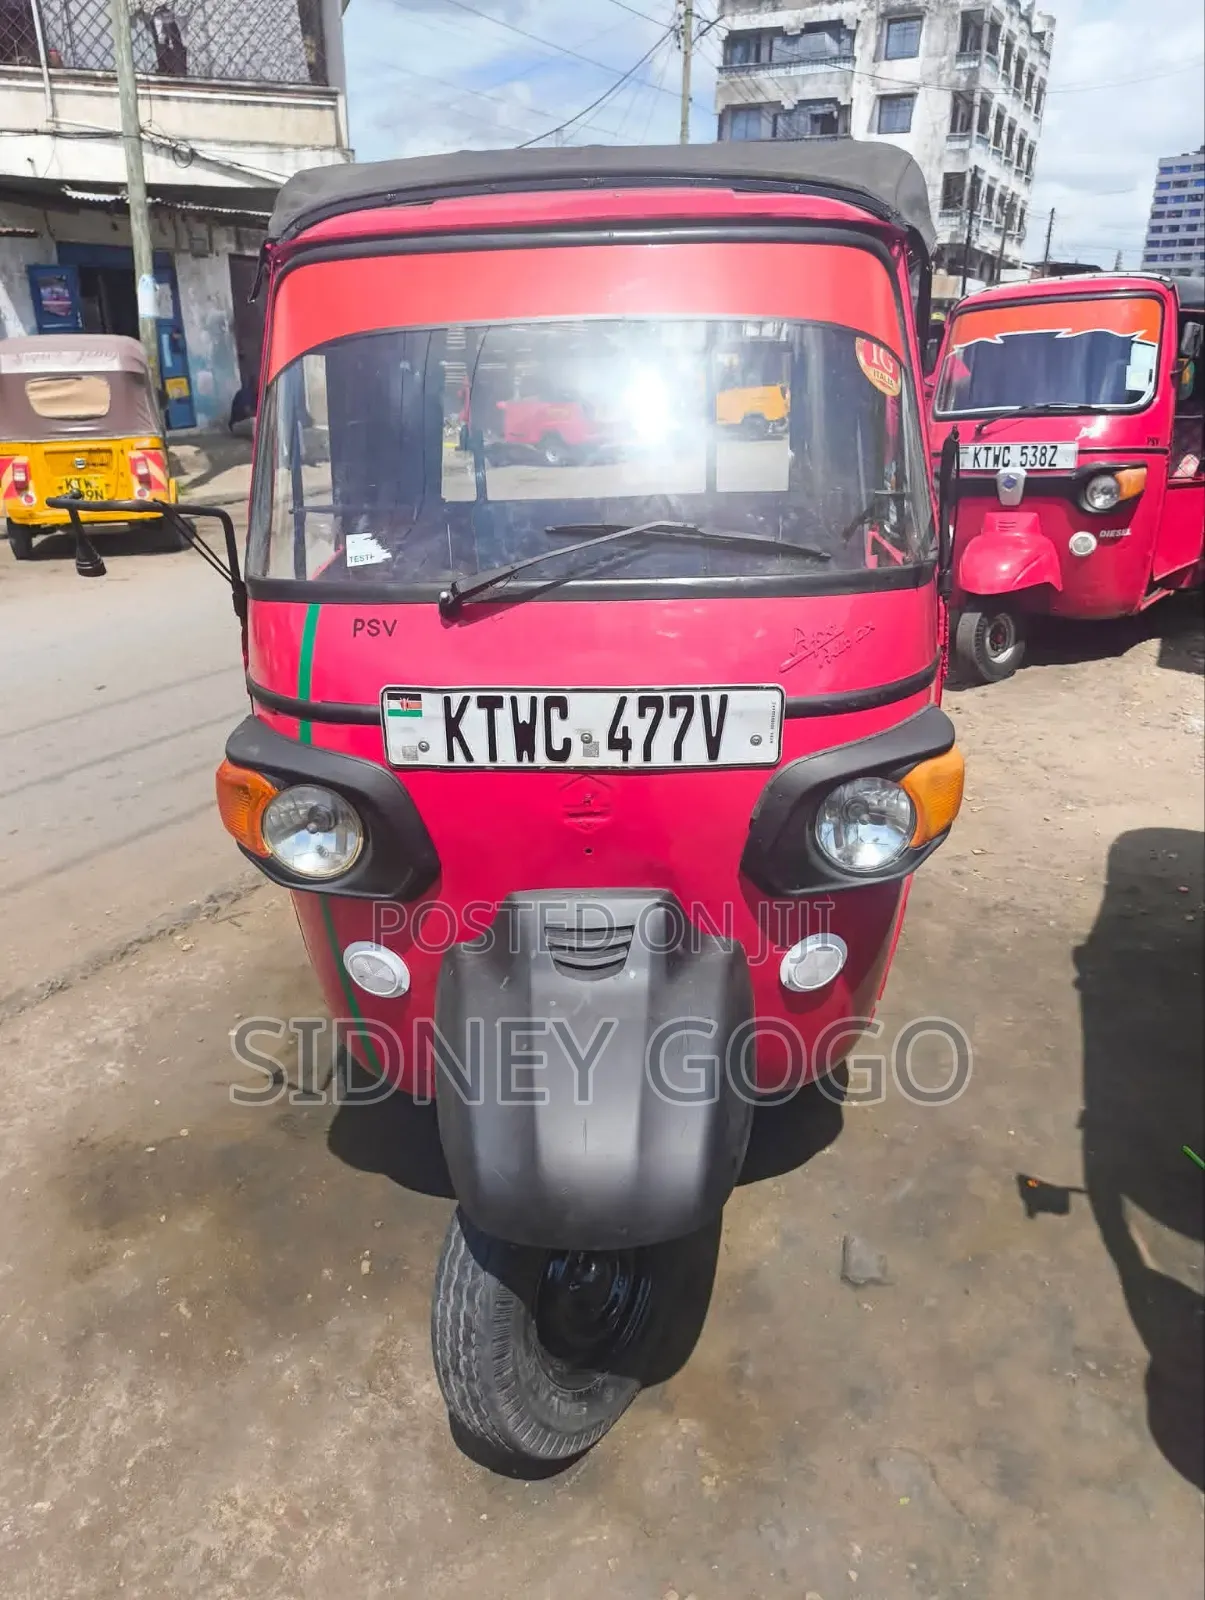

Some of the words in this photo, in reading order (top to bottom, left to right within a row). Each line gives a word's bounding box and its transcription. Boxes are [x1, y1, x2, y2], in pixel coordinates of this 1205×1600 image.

[873, 368, 894, 387] ITALIA
[972, 445, 1011, 468] KTWC
[1020, 445, 1058, 467] 538Z
[64, 477, 99, 489] KTW
[1099, 528, 1132, 538] DIESEL
[353, 618, 397, 637] PSV
[443, 695, 572, 762] KTWC
[607, 694, 728, 762] 477V
